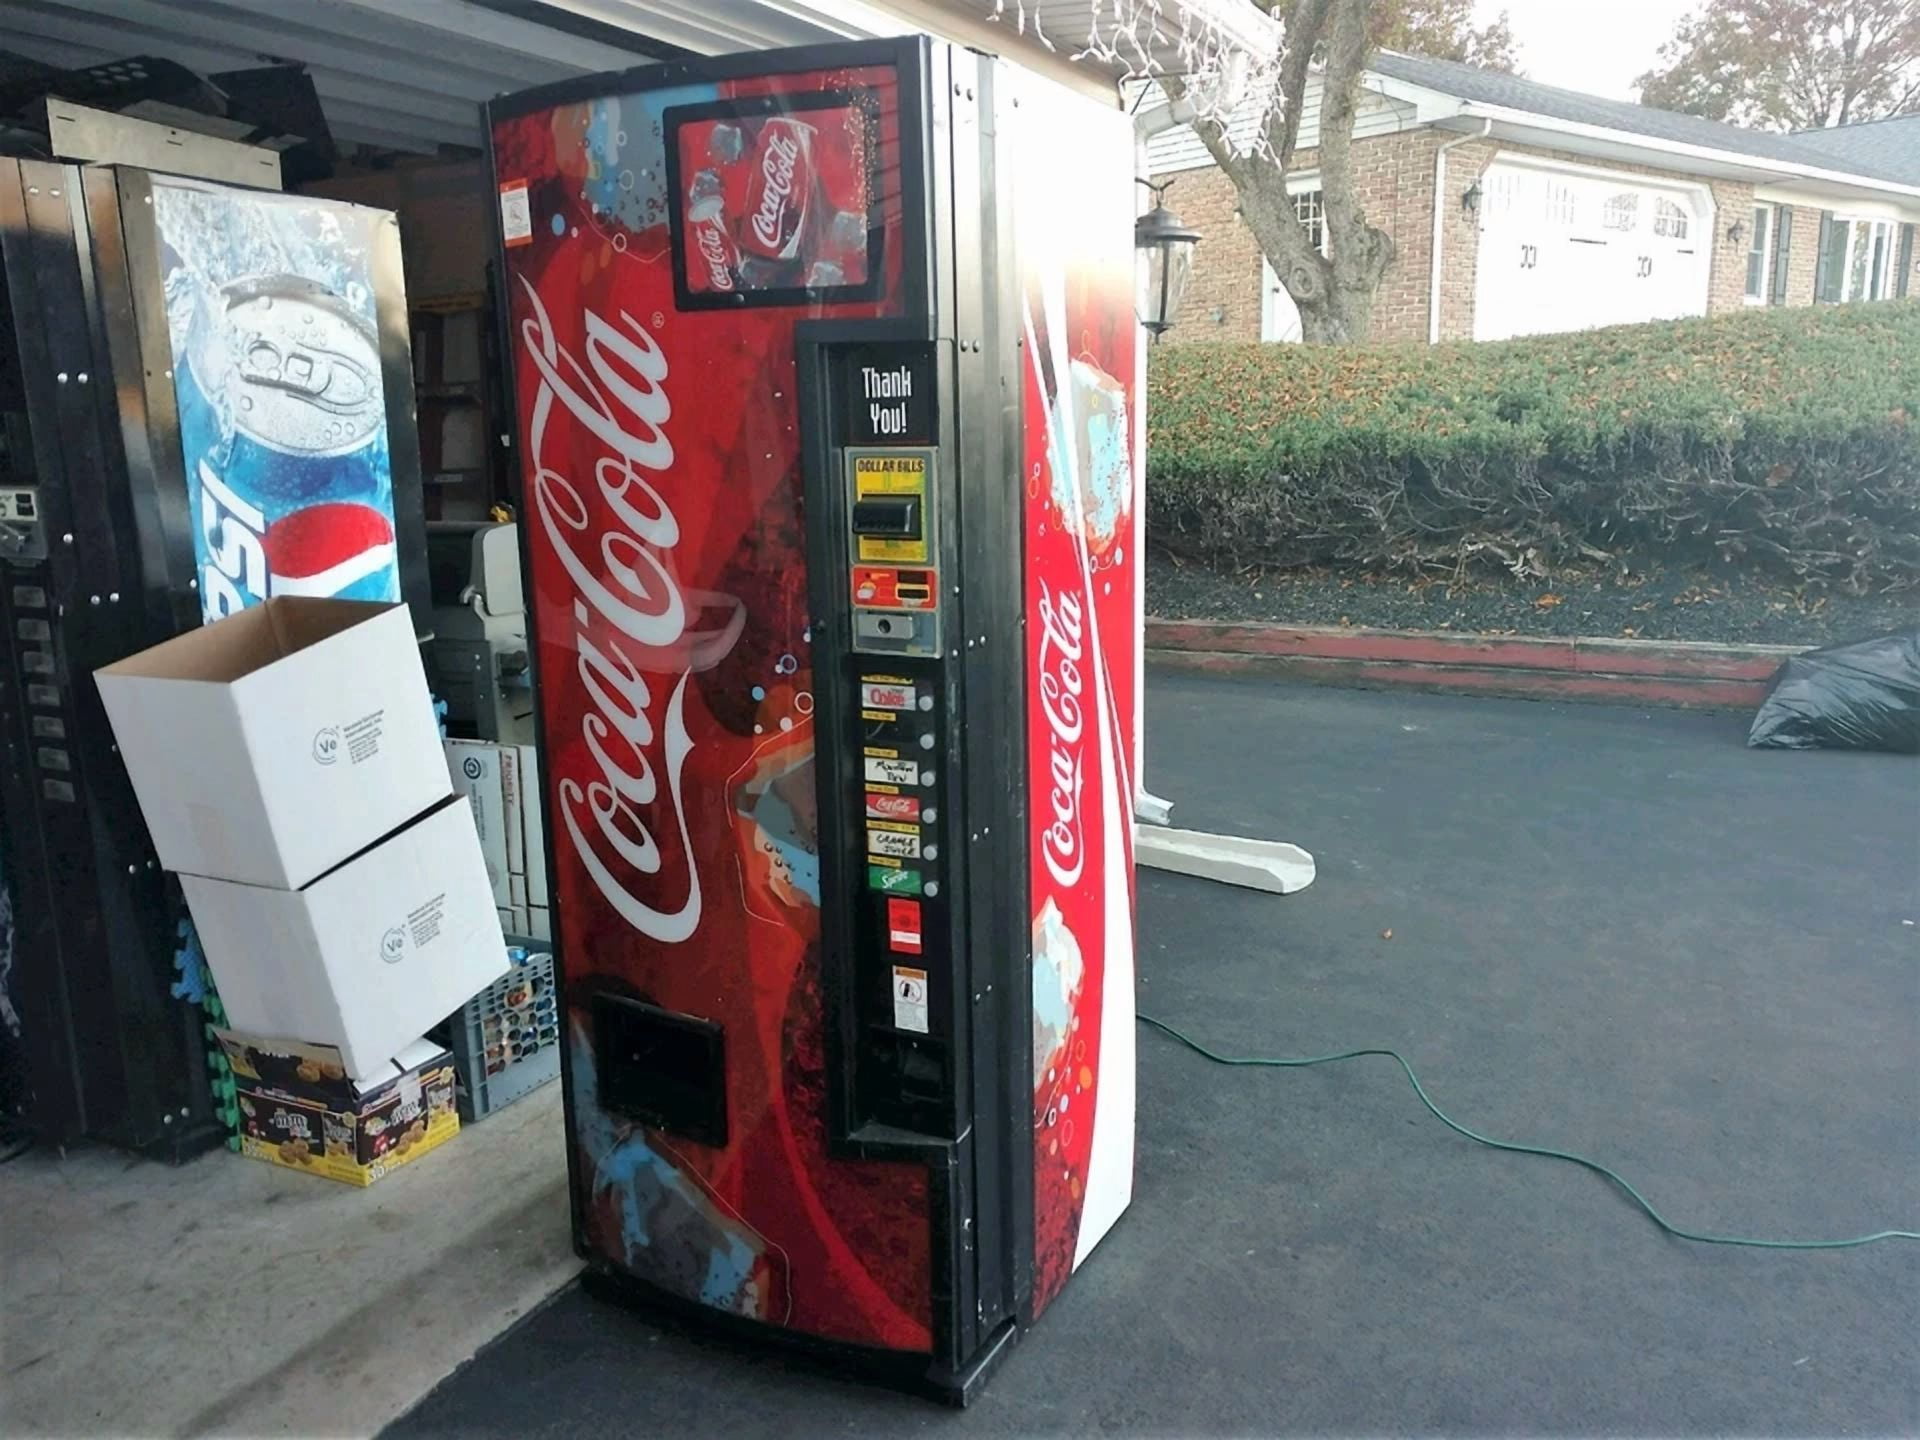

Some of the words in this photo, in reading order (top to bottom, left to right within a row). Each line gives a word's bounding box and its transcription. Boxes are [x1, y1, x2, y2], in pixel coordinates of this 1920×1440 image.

[862, 365, 912, 399] Thank
[870, 402, 907, 434] You!
[857, 459, 895, 473] DOLLAR
[897, 460, 925, 473] BILLS
[517, 272, 701, 943] Coca-Cola
[1039, 576, 1085, 888] Coca-Cola
